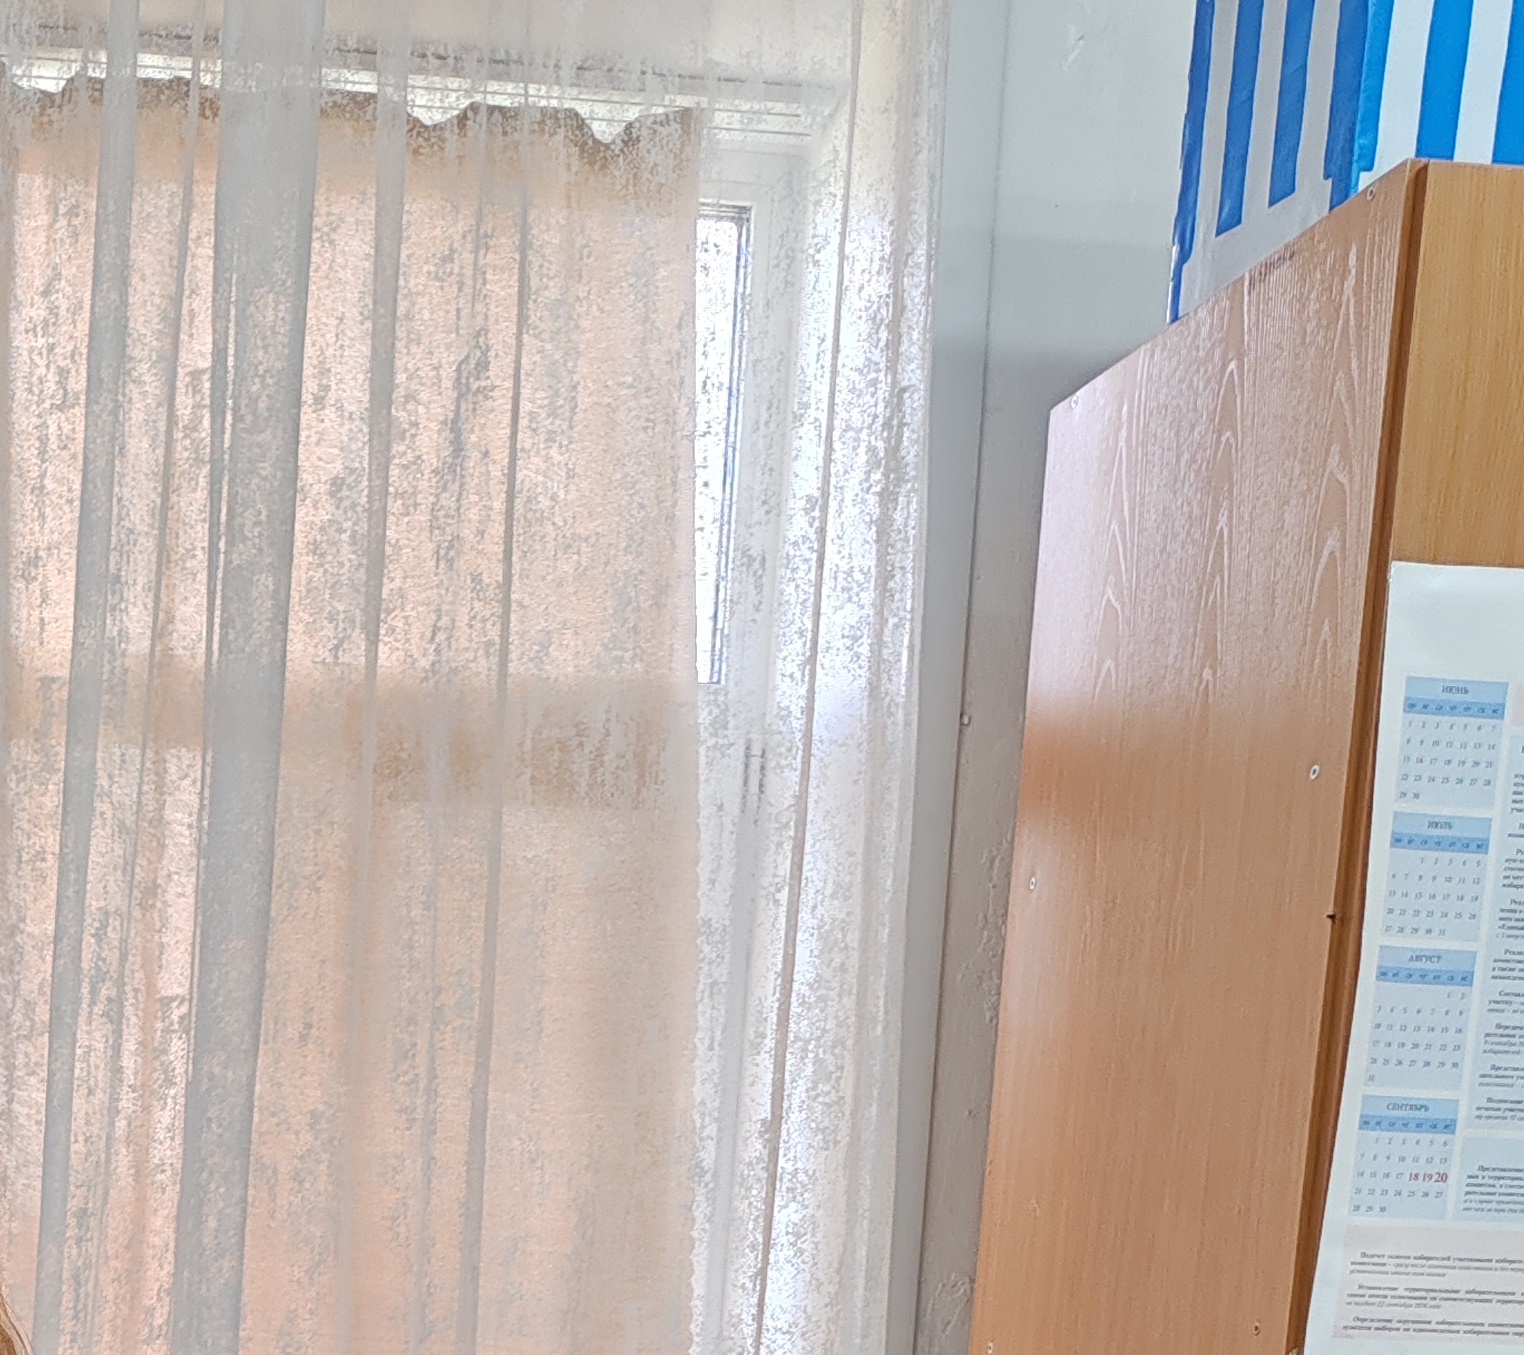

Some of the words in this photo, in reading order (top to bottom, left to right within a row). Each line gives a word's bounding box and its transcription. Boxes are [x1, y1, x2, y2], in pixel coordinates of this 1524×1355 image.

[1408, 954, 1442, 964] АВГУСТ
[1408, 1172, 1419, 1181] 18
[1422, 1173, 1433, 1182] 19
[1434, 1172, 1448, 1183] 20
